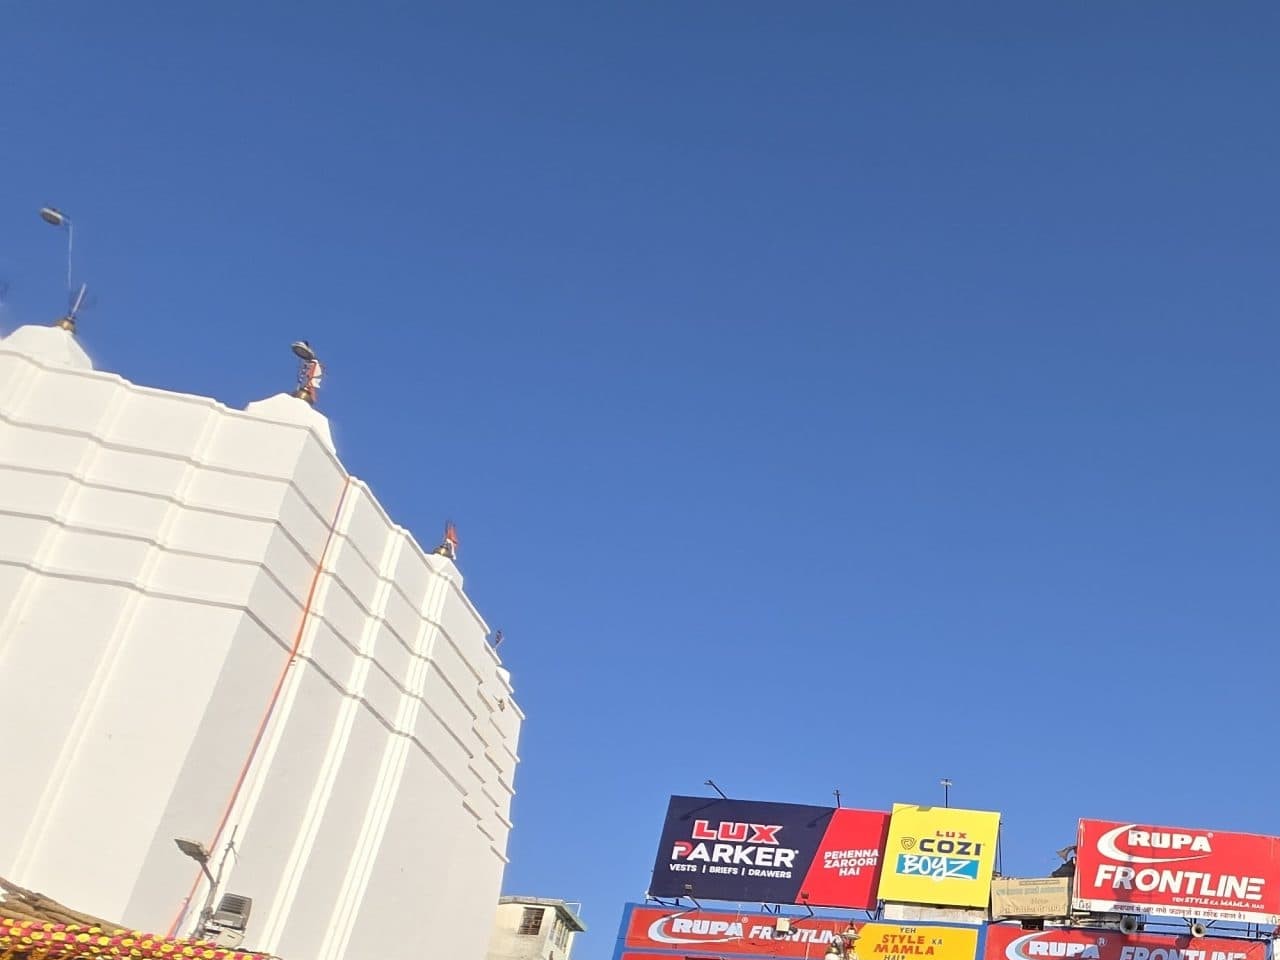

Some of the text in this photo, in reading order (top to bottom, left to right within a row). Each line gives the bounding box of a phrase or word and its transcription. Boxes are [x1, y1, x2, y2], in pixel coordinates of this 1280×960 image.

[692, 820, 783, 845] LUX
[936, 830, 967, 839] LUX
[919, 839, 982, 856] COZI
[1128, 830, 1212, 853] RUPA
[671, 841, 797, 868] PARKER
[824, 849, 879, 860] PEHENNA
[669, 863, 792, 879] VESTS BRIEFS DRAWERS
[824, 858, 877, 868] ZAROORI
[839, 867, 860, 877] HAI
[1094, 864, 1266, 900] FRONTLINE
[1184, 897, 1210, 905] STYLE
[1219, 899, 1250, 908] MAMLA
[671, 918, 744, 937] RUPA
[882, 934, 925, 945] STYLE
[873, 944, 935, 955] MAMLA
[1028, 941, 1101, 959] RUPA
